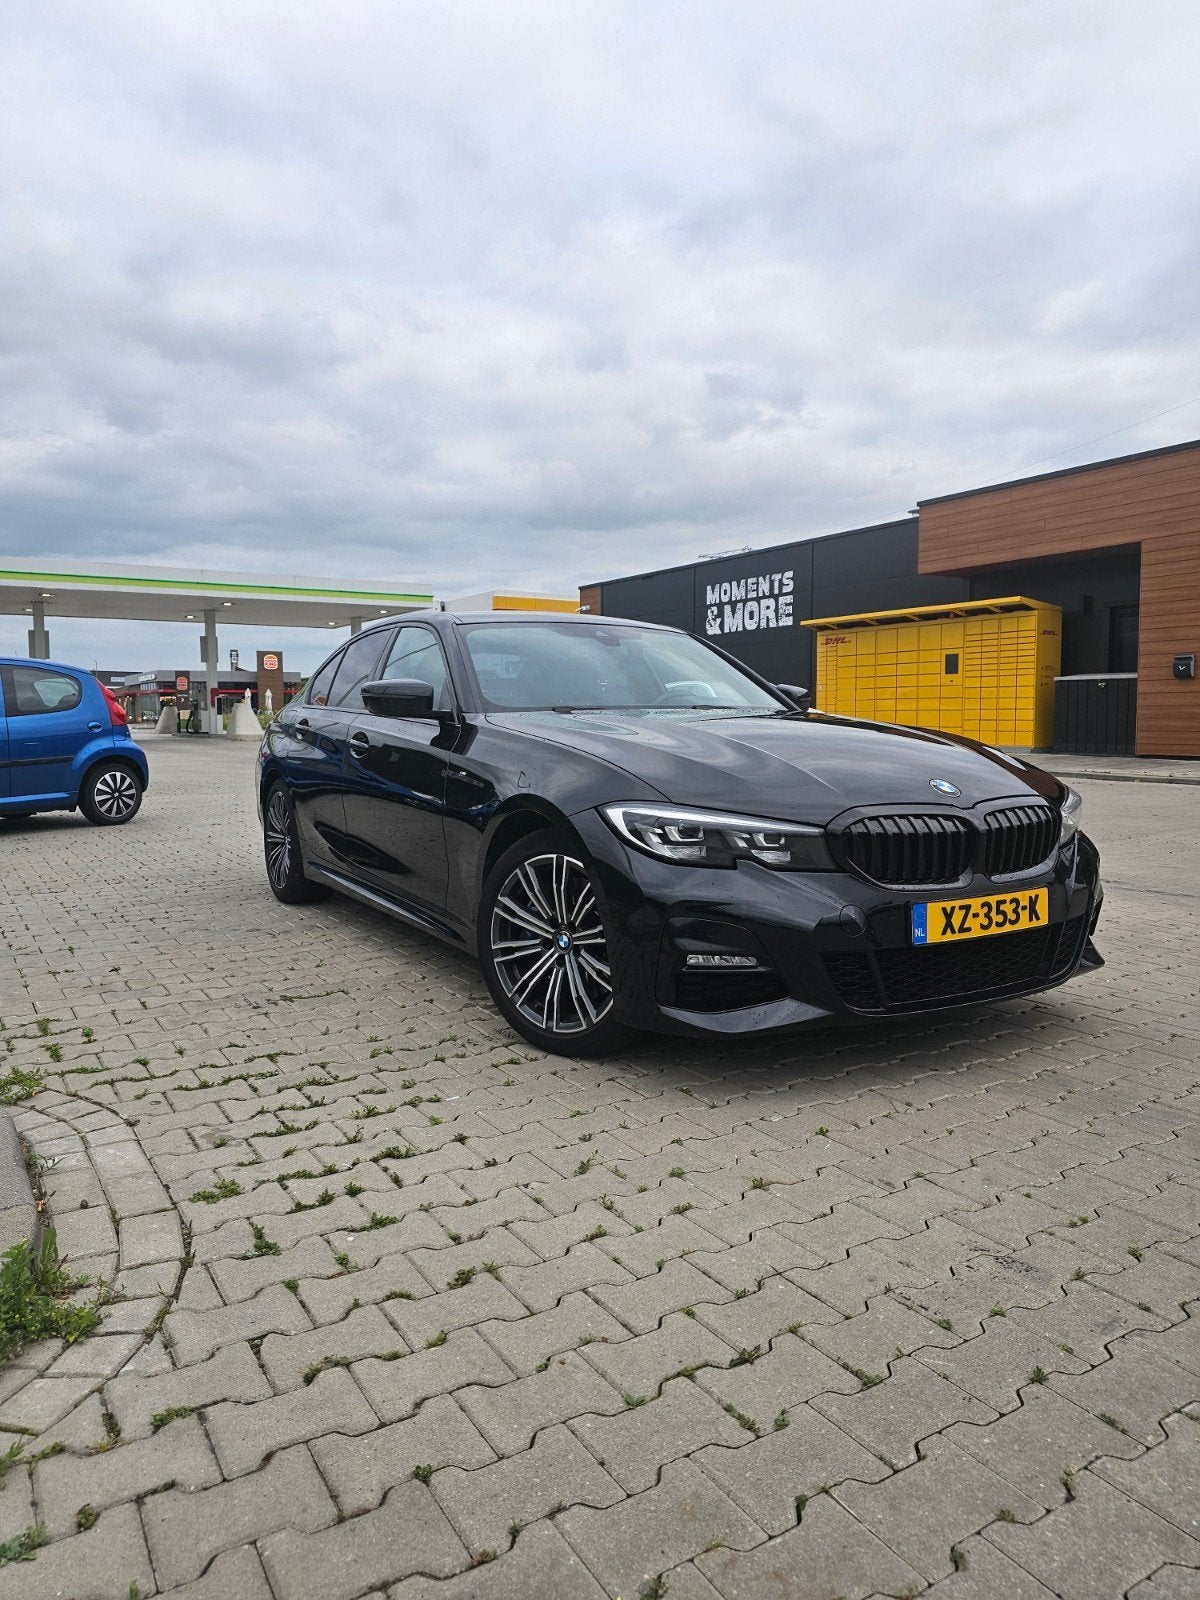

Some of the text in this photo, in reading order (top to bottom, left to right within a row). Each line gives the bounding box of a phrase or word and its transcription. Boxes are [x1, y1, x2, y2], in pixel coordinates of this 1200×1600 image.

[706, 570, 794, 605] MOMENTS
[825, 636, 847, 645] DHL
[941, 894, 1041, 935] XZ-353-K
[914, 928, 925, 938] NL
